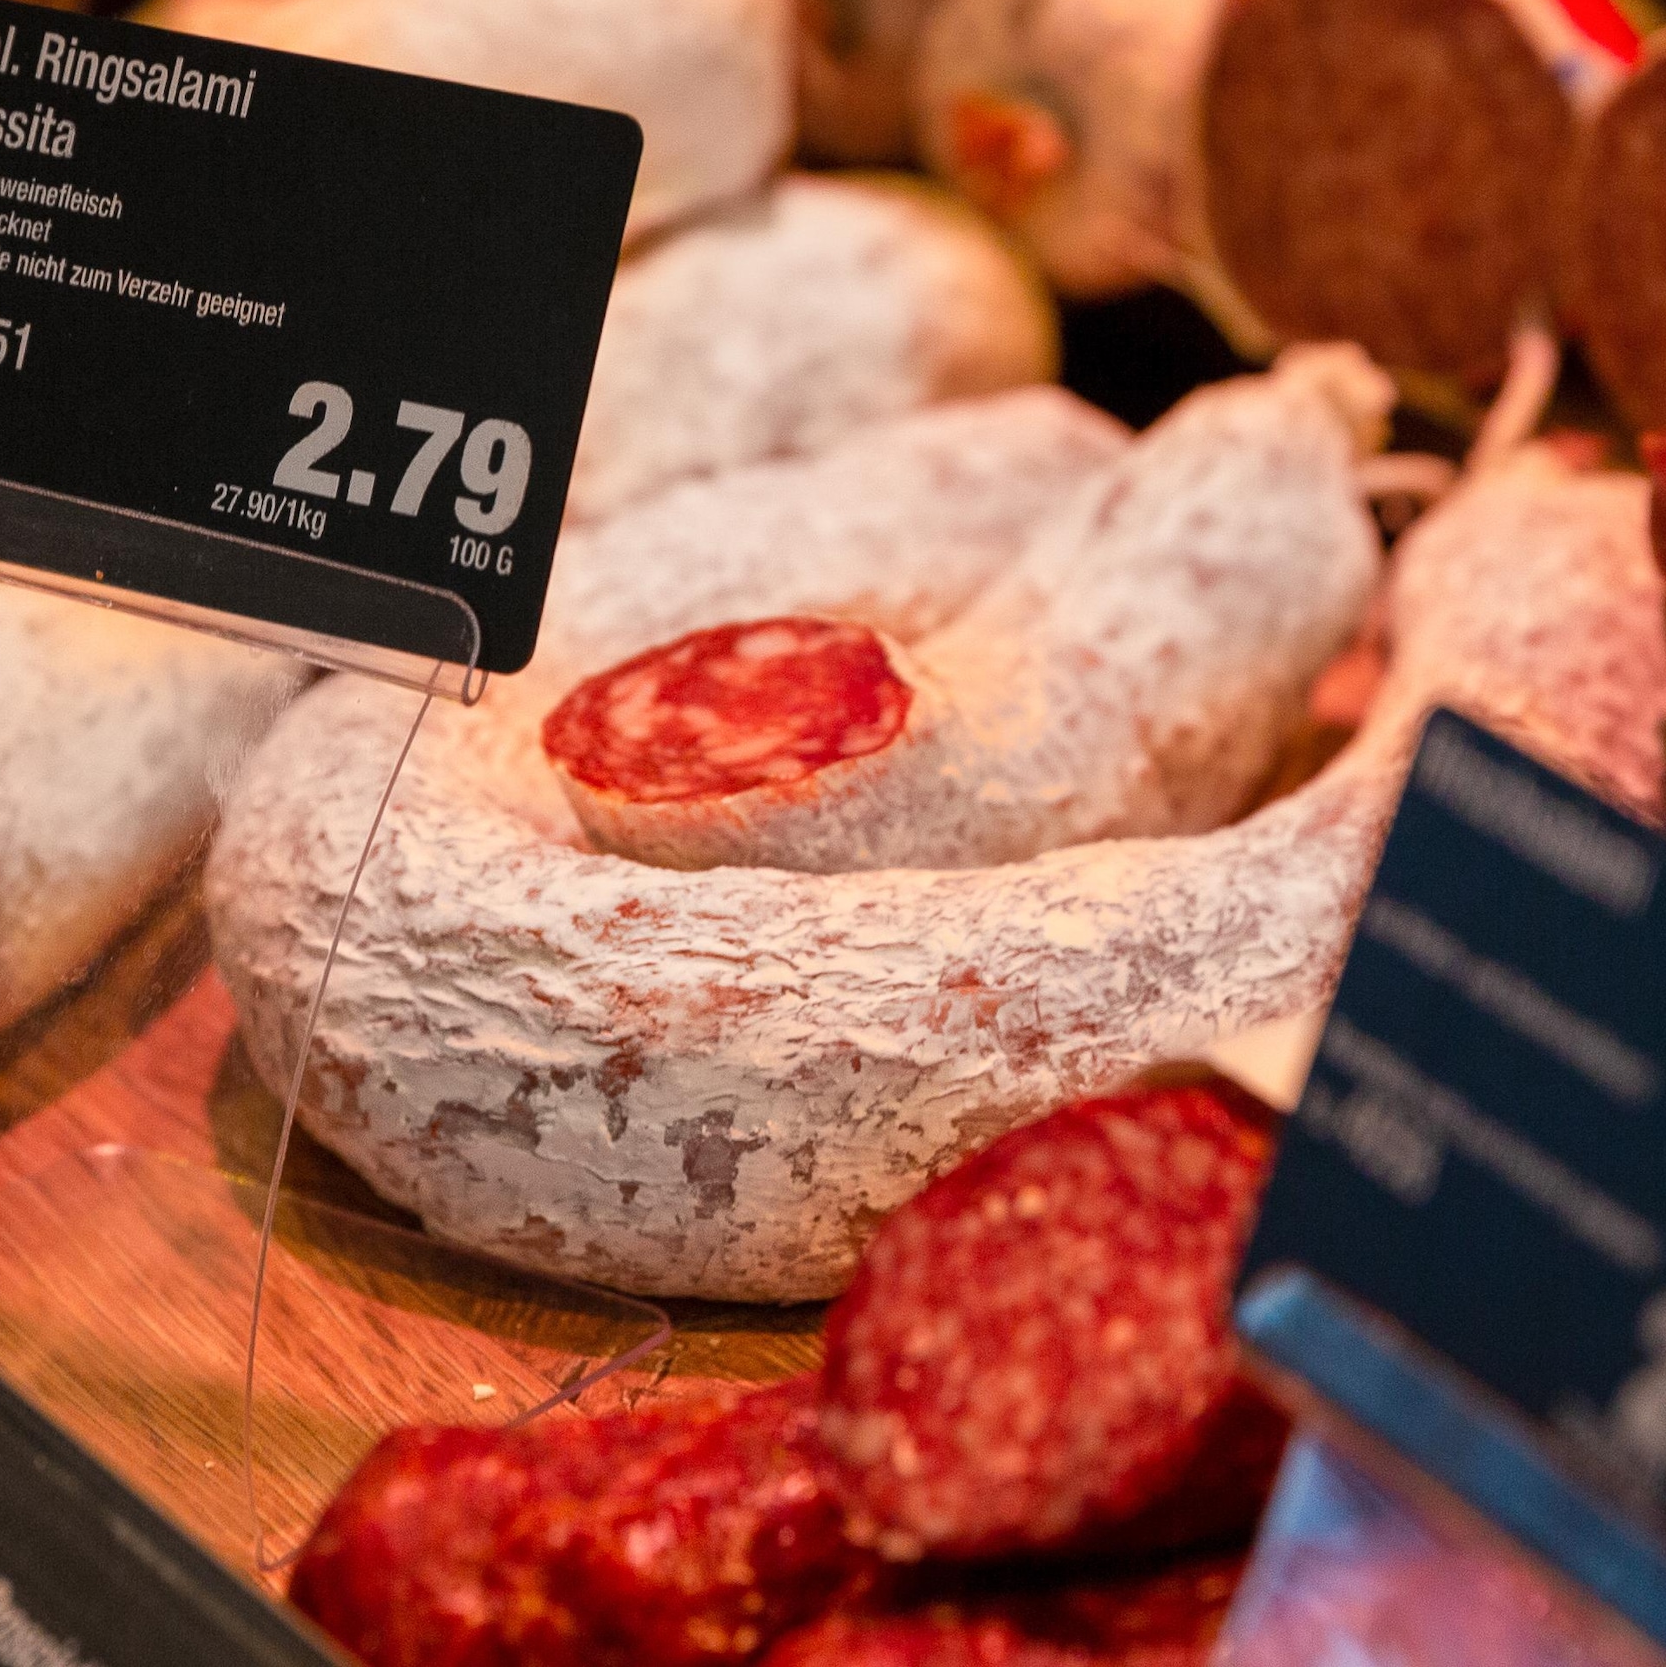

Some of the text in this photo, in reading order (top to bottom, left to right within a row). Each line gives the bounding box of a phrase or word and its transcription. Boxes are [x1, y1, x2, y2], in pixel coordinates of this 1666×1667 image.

[34, 31, 258, 120] Ringsalami
[15, 249, 68, 285] nicht
[69, 263, 113, 295] zum
[116, 269, 194, 312] Verzehr
[195, 285, 288, 330] geeignet
[271, 379, 534, 539] 2.79
[209, 481, 516, 577] 27.90/1kg 100 G
